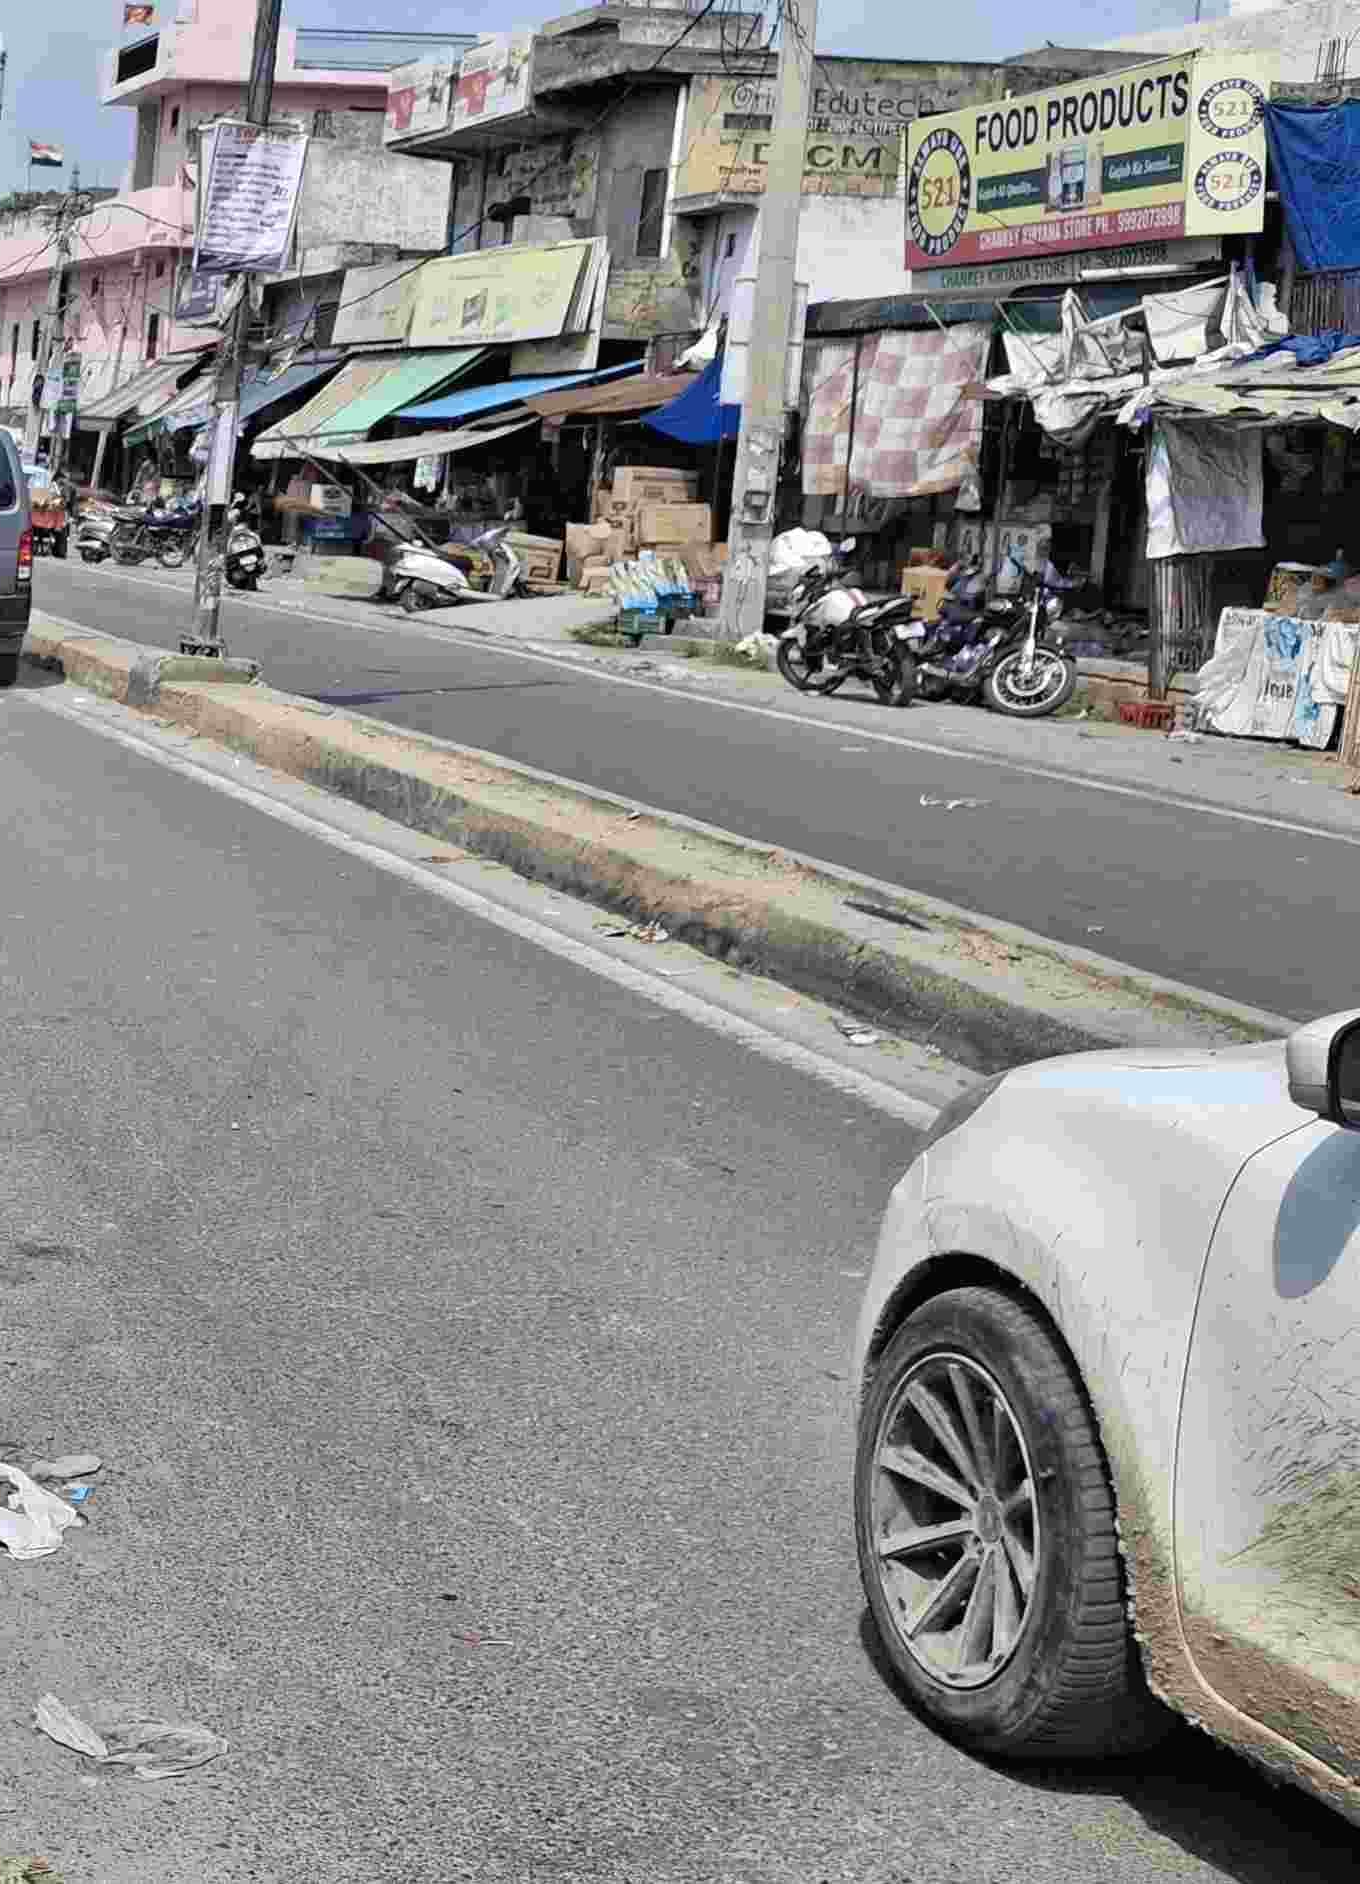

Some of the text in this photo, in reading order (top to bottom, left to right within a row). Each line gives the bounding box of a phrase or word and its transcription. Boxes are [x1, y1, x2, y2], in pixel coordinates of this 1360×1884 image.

[975, 70, 1189, 154] FOOD PRODUCTS
[1214, 100, 1249, 117] 521
[921, 175, 960, 210] 521
[1211, 172, 1247, 190] 521
[1063, 217, 1094, 240] STORE
